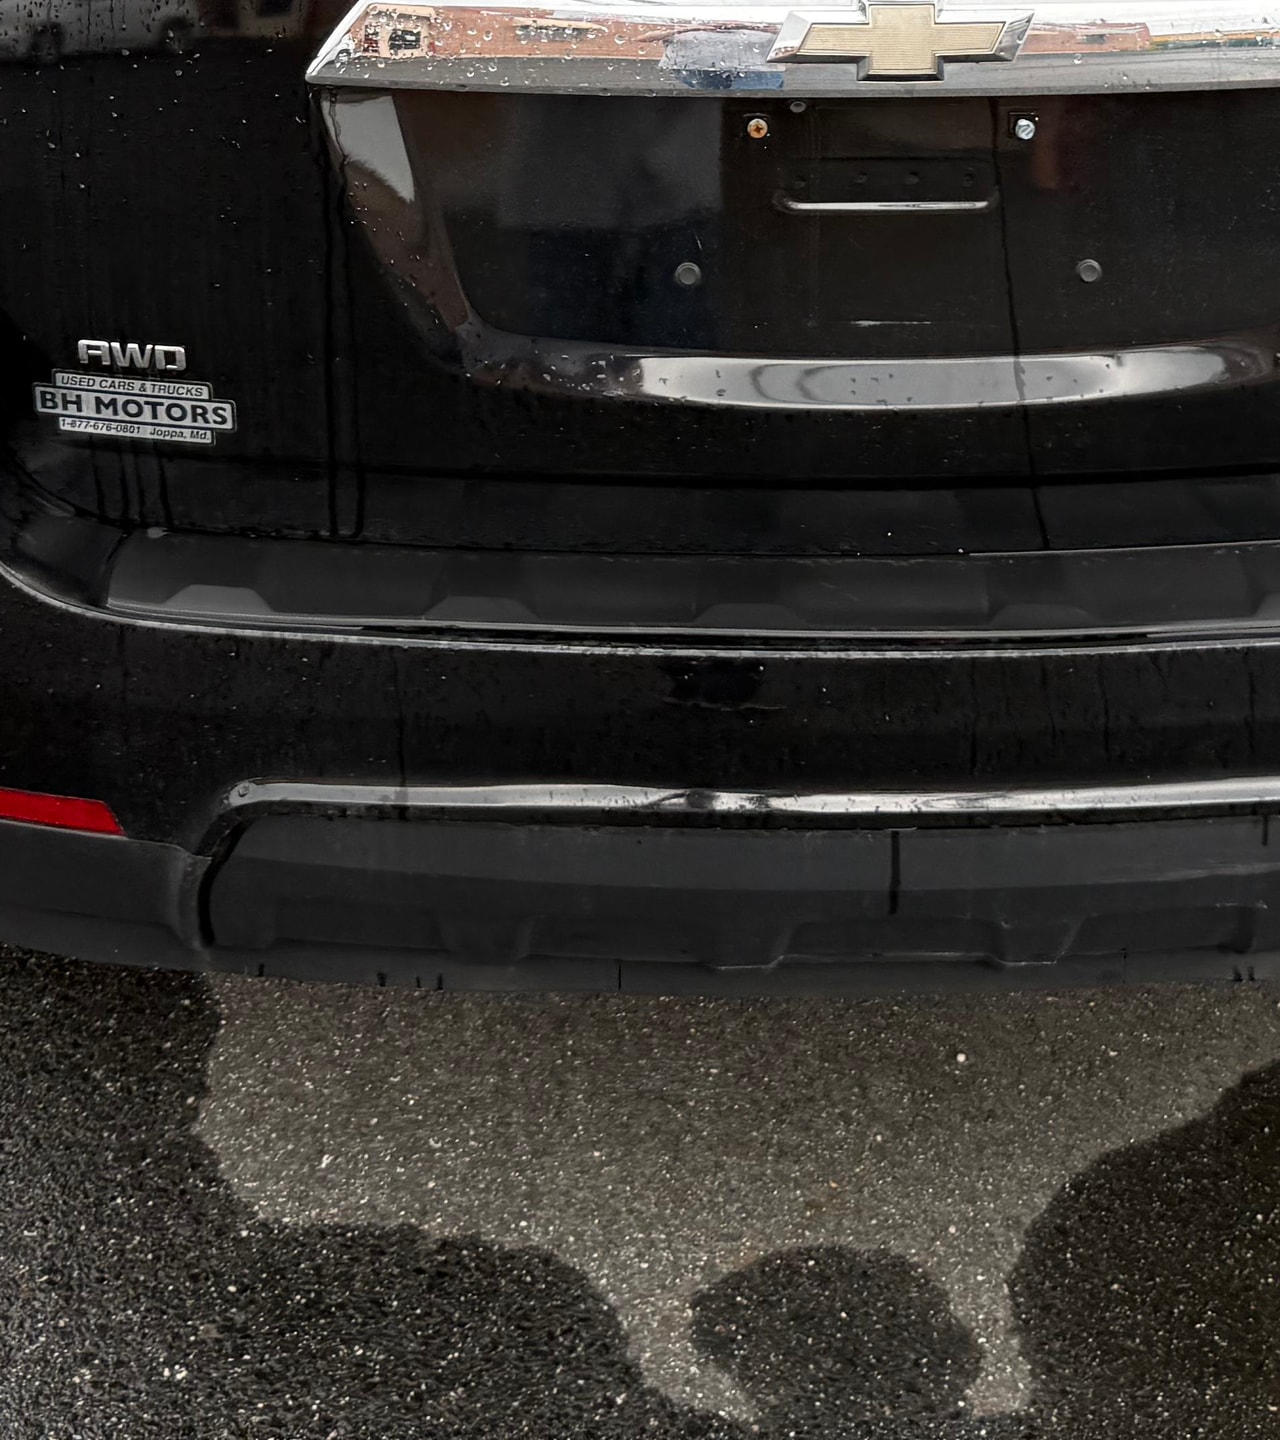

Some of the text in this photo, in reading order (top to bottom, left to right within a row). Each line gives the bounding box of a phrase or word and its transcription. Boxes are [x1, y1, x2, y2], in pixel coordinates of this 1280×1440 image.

[77, 339, 187, 371] AWD
[61, 375, 204, 397] USED CARS & TRUCKS
[39, 390, 228, 426] BH MOTORS
[189, 429, 210, 441] Md.
